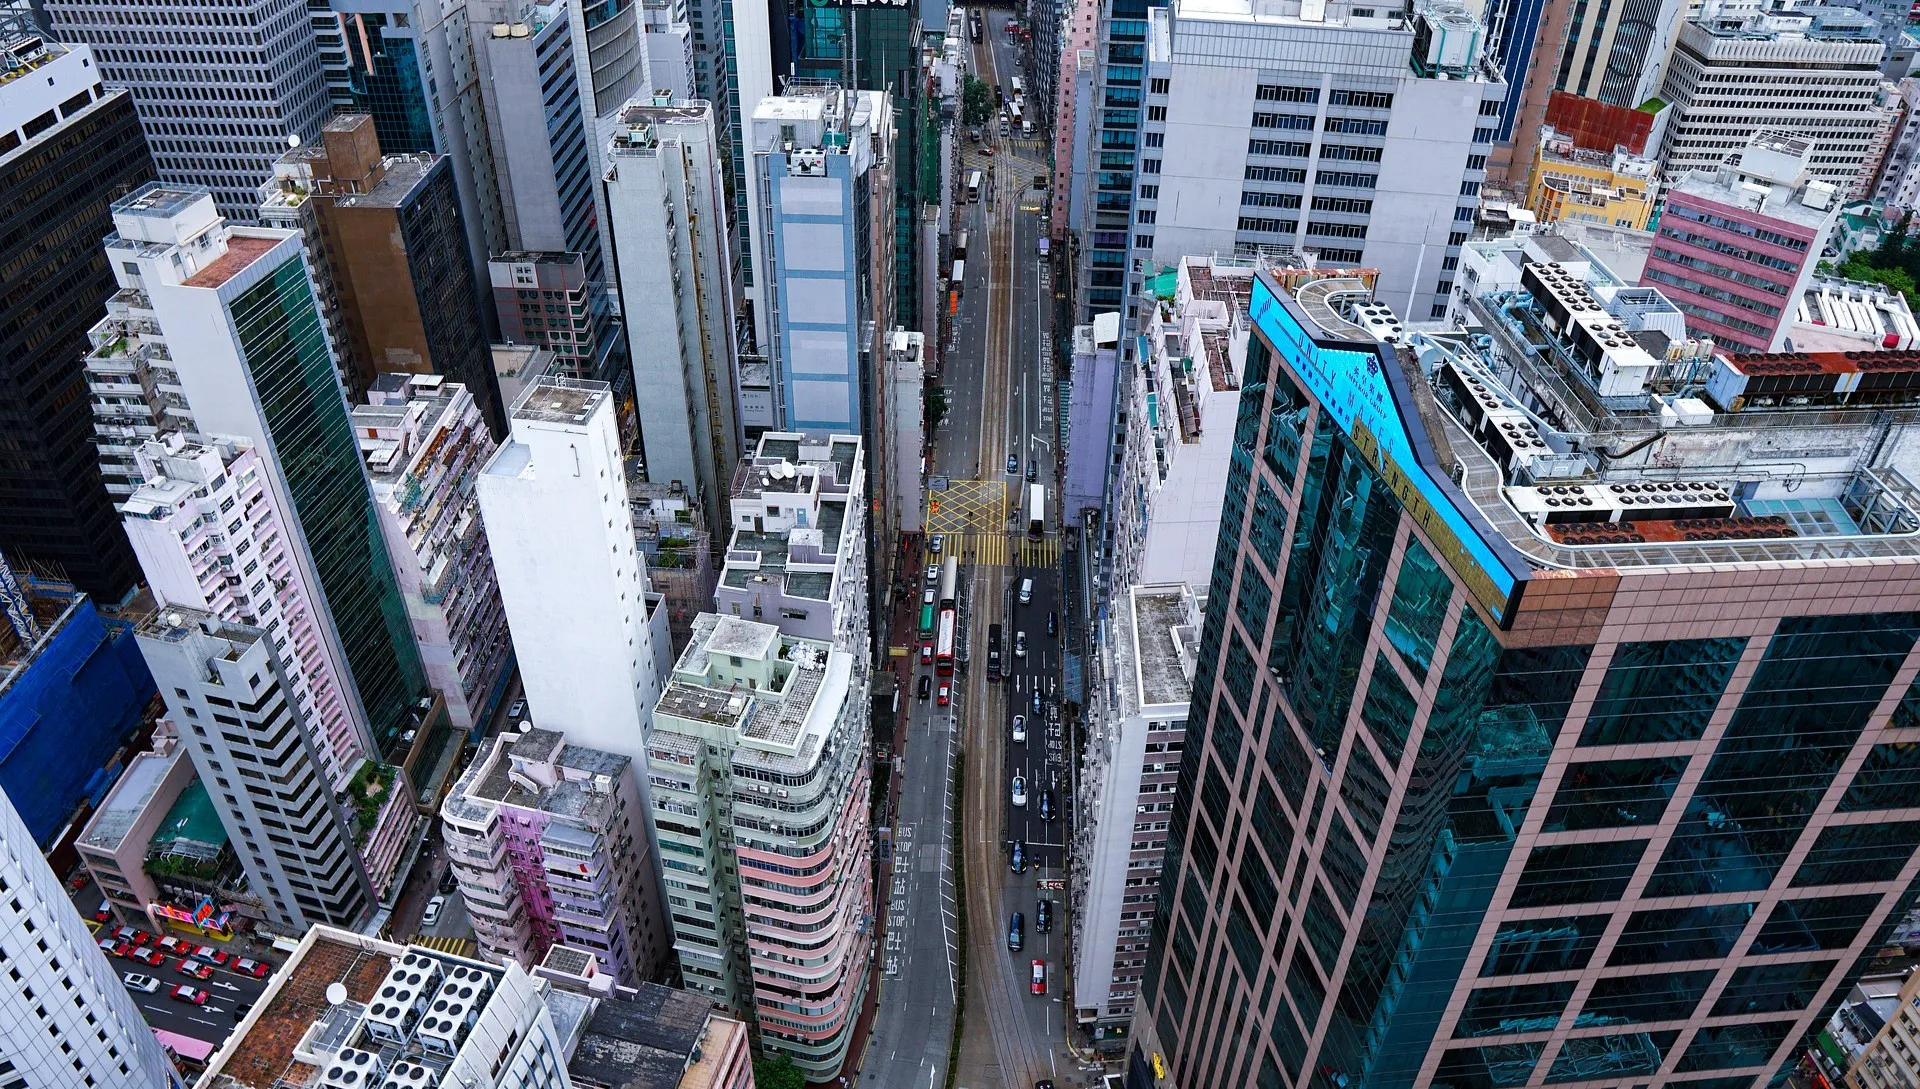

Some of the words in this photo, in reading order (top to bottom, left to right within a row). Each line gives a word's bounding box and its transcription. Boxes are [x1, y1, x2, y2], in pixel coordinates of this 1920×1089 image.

[1298, 332, 1337, 387] UNITY
[1347, 390, 1394, 453] MAKES
[1353, 425, 1431, 528] STRENGTH
[1048, 722, 1061, 737] 巴士
[1047, 740, 1062, 750] STOP
[1048, 753, 1061, 762] BUS
[898, 827, 912, 838] BUS
[895, 841, 912, 852] STOP
[894, 856, 909, 873] 巴士
[893, 877, 906, 895] 站
[890, 899, 905, 911] BUS
[887, 915, 905, 927] STOP
[886, 931, 902, 951] 巴士
[885, 955, 898, 975] 站
